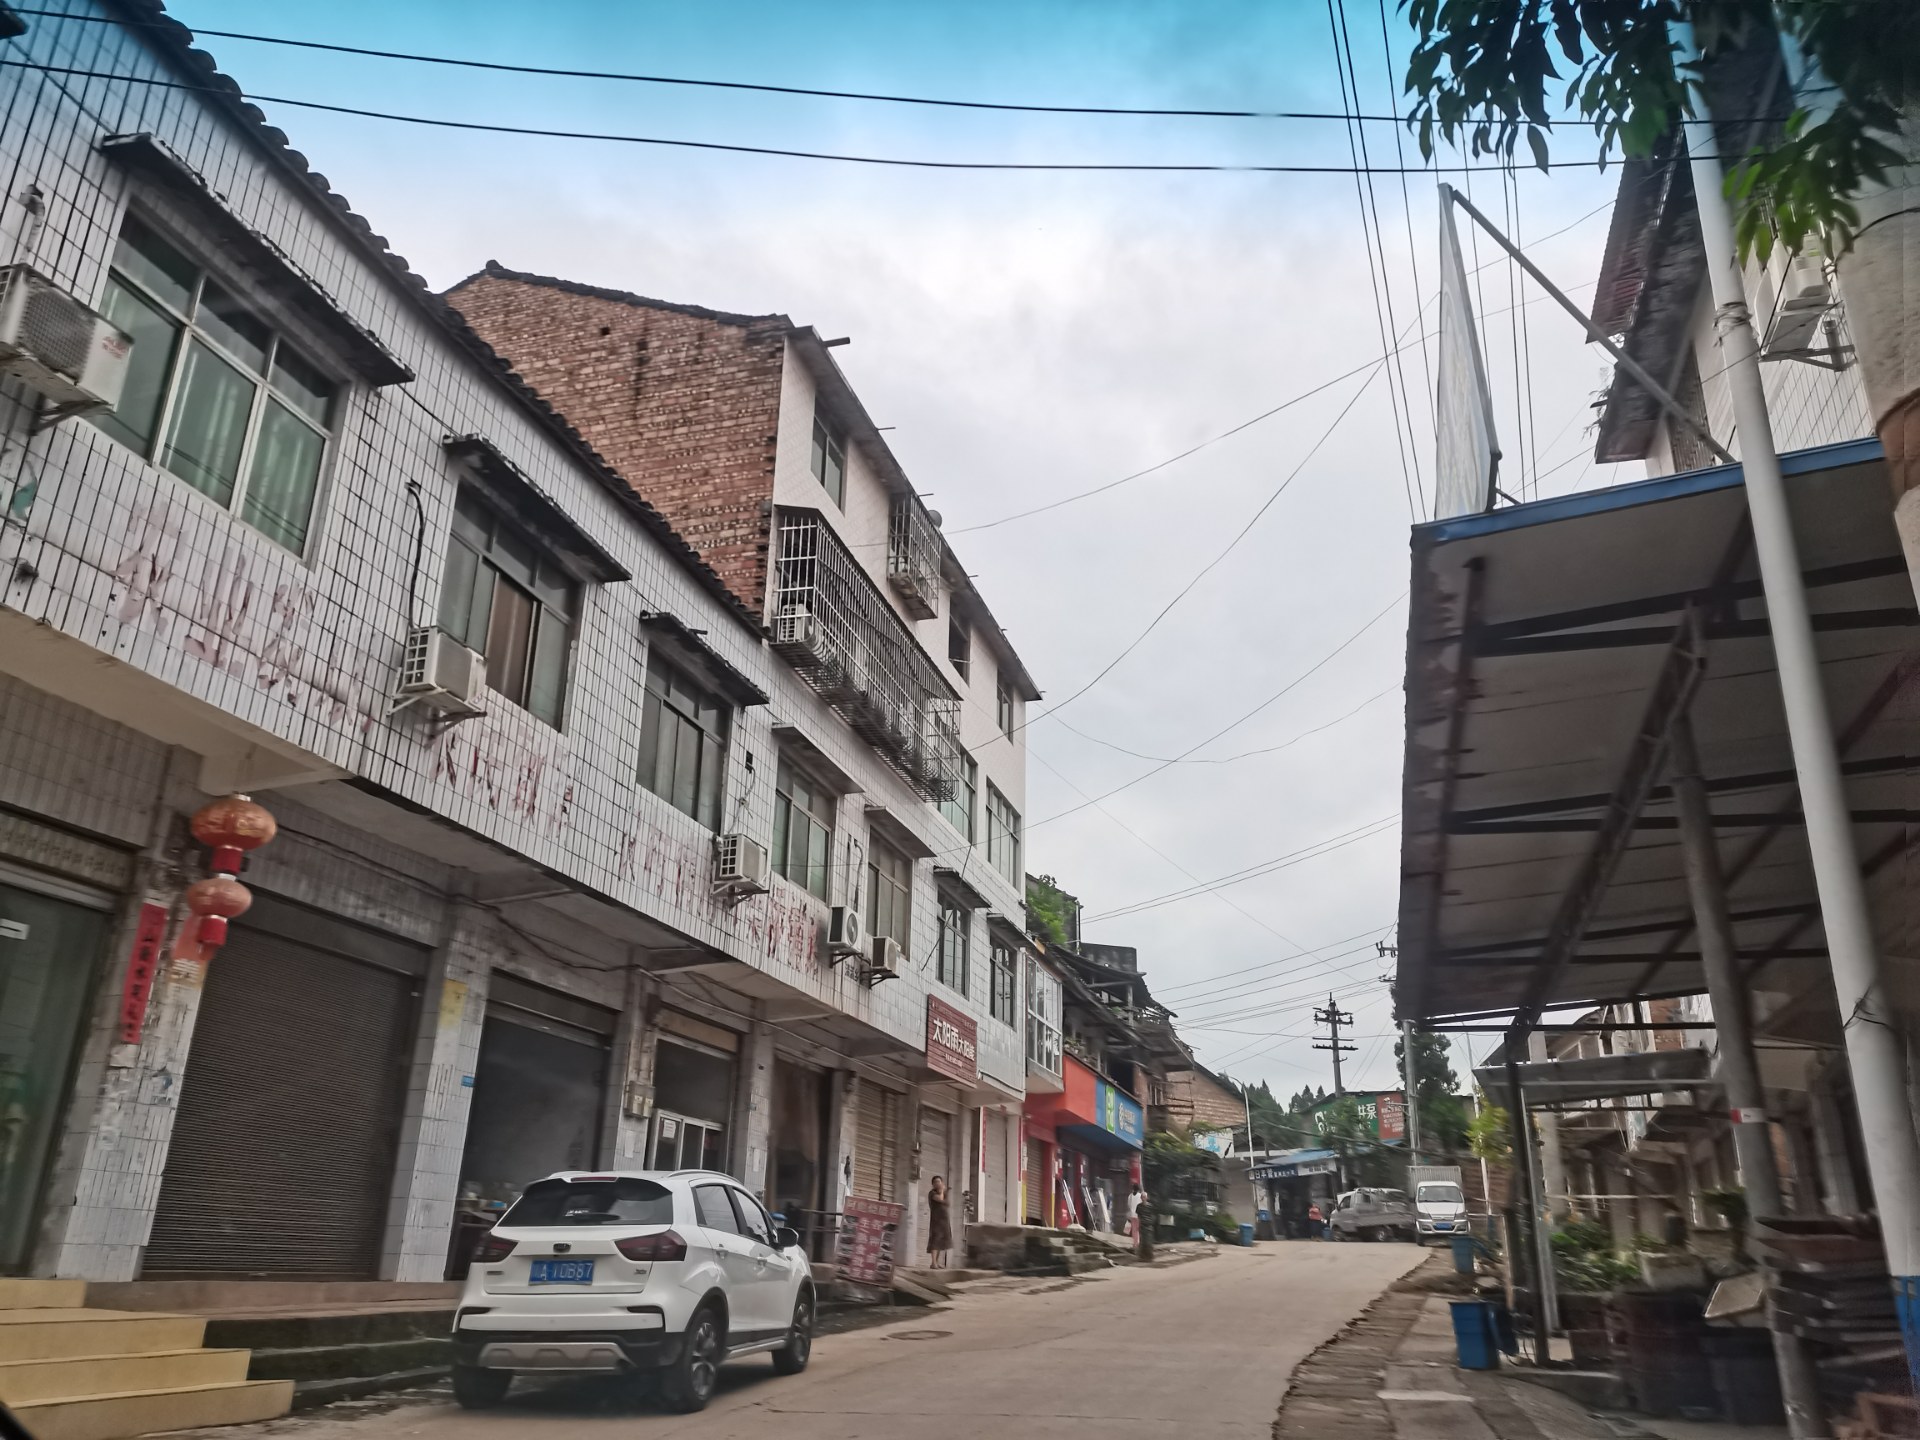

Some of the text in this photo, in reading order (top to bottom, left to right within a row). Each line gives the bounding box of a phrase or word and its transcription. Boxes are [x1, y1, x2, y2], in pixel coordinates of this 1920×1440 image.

[932, 1017, 975, 1061] 太阳雨太阳能
